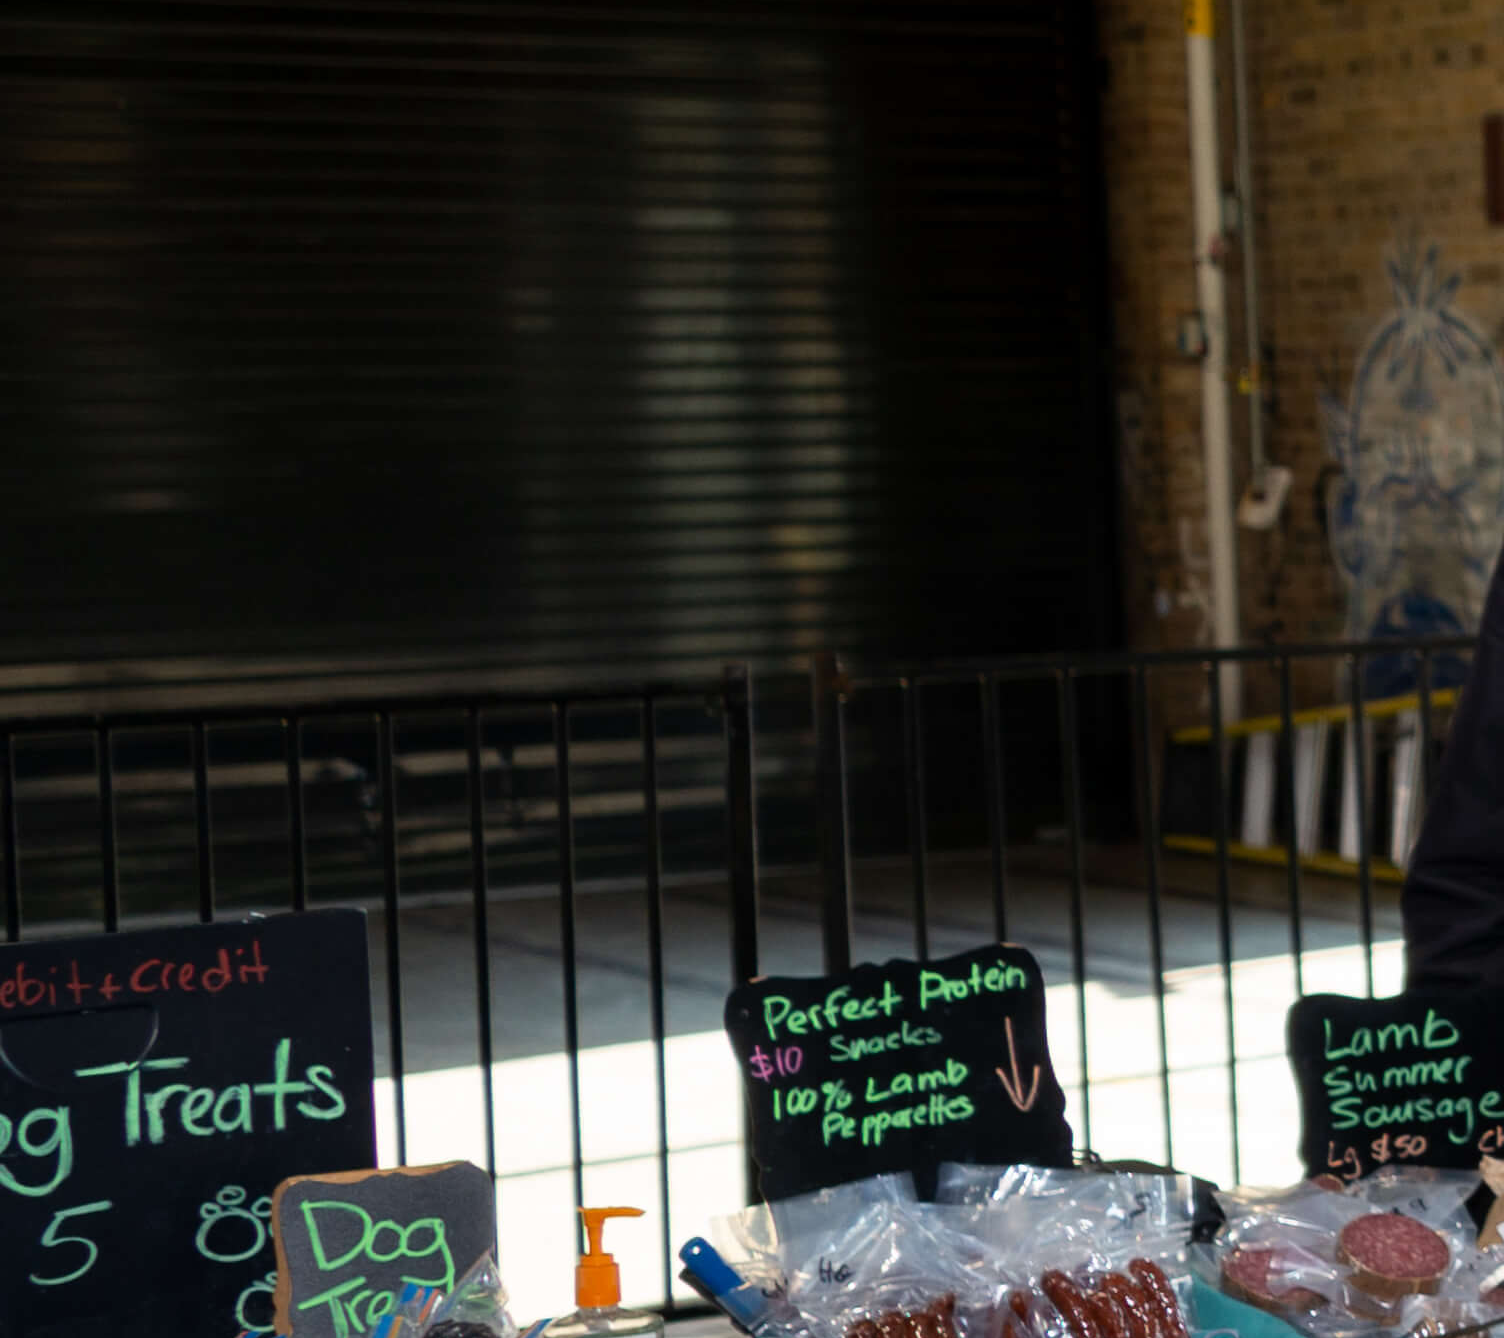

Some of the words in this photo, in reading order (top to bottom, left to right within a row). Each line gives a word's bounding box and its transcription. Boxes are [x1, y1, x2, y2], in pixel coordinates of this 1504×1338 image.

[762, 979, 903, 1041] Perfect
[919, 959, 1027, 1011] Protein
[829, 1020, 942, 1062] Snacks
[1323, 1008, 1460, 1060] Lamb
[74, 1037, 347, 1146] Treats
[750, 1045, 803, 1082] $10
[772, 1079, 853, 1121] 100%
[865, 1058, 968, 1102] Lamb
[1323, 1054, 1473, 1097] Summer
[1370, 1132, 1428, 1163] $50
[29, 1199, 113, 1286] 5
[300, 1201, 456, 1293] Dog
